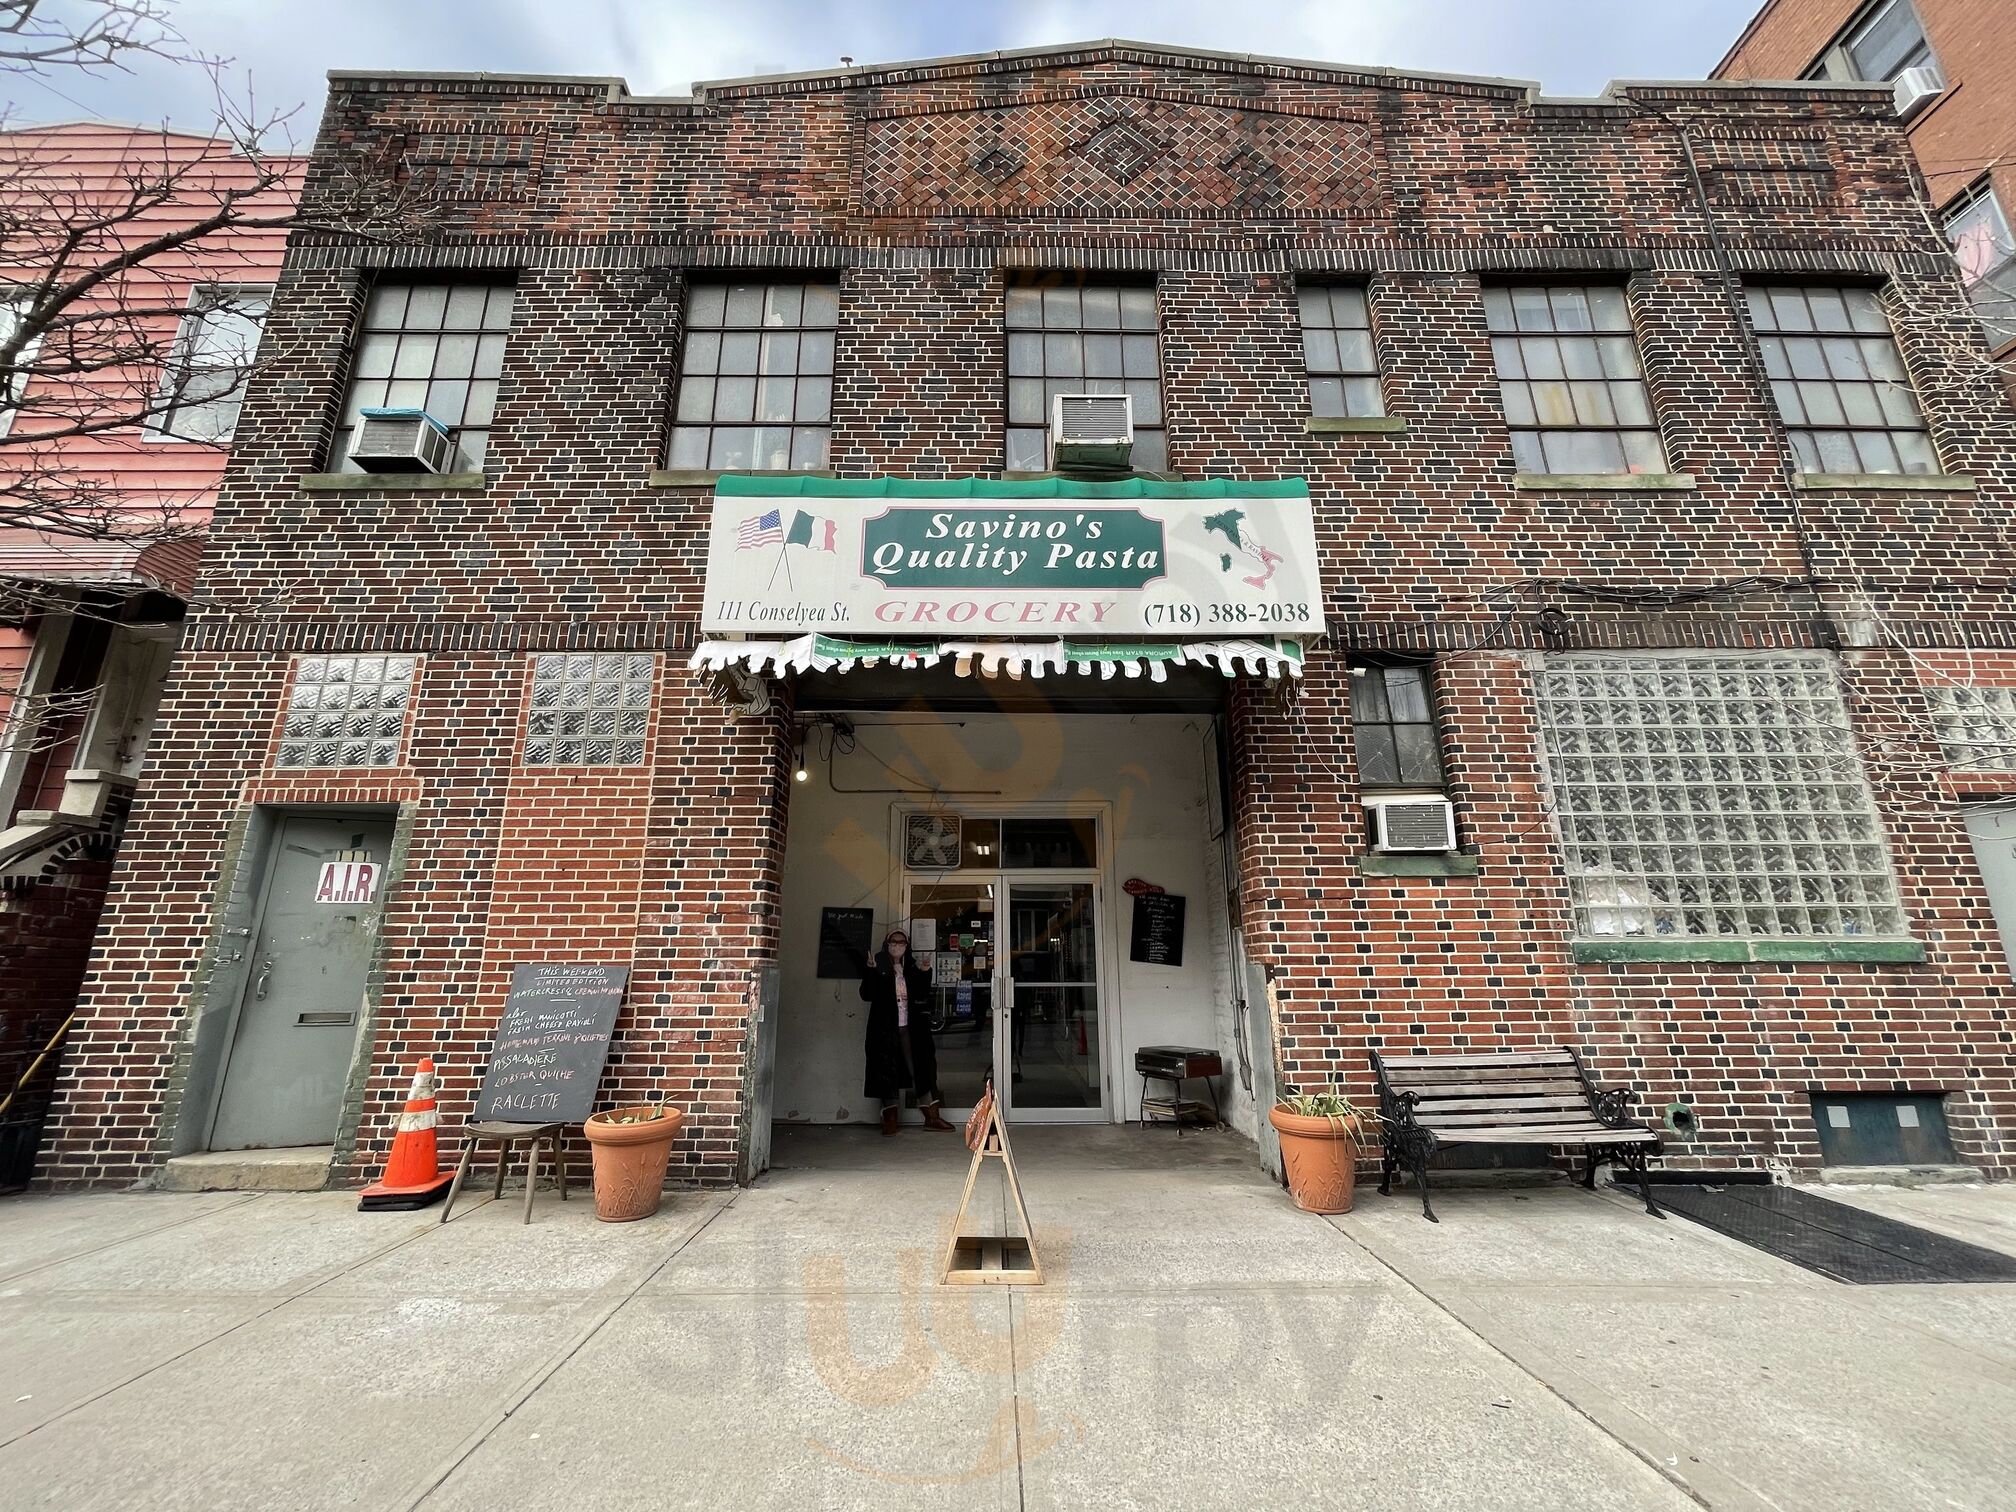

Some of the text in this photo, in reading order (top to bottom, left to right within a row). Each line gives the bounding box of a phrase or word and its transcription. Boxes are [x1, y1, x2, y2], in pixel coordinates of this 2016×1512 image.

[925, 513, 1103, 540] Savino's
[872, 542, 1159, 575] Quality Pasta
[716, 600, 850, 627] 111 Conselyea St.
[874, 601, 1116, 623] GROCERY
[1144, 602, 1310, 628] (718) 388-2038
[318, 864, 376, 902] A.I.R.
[491, 1092, 561, 1114] RACLETTE
